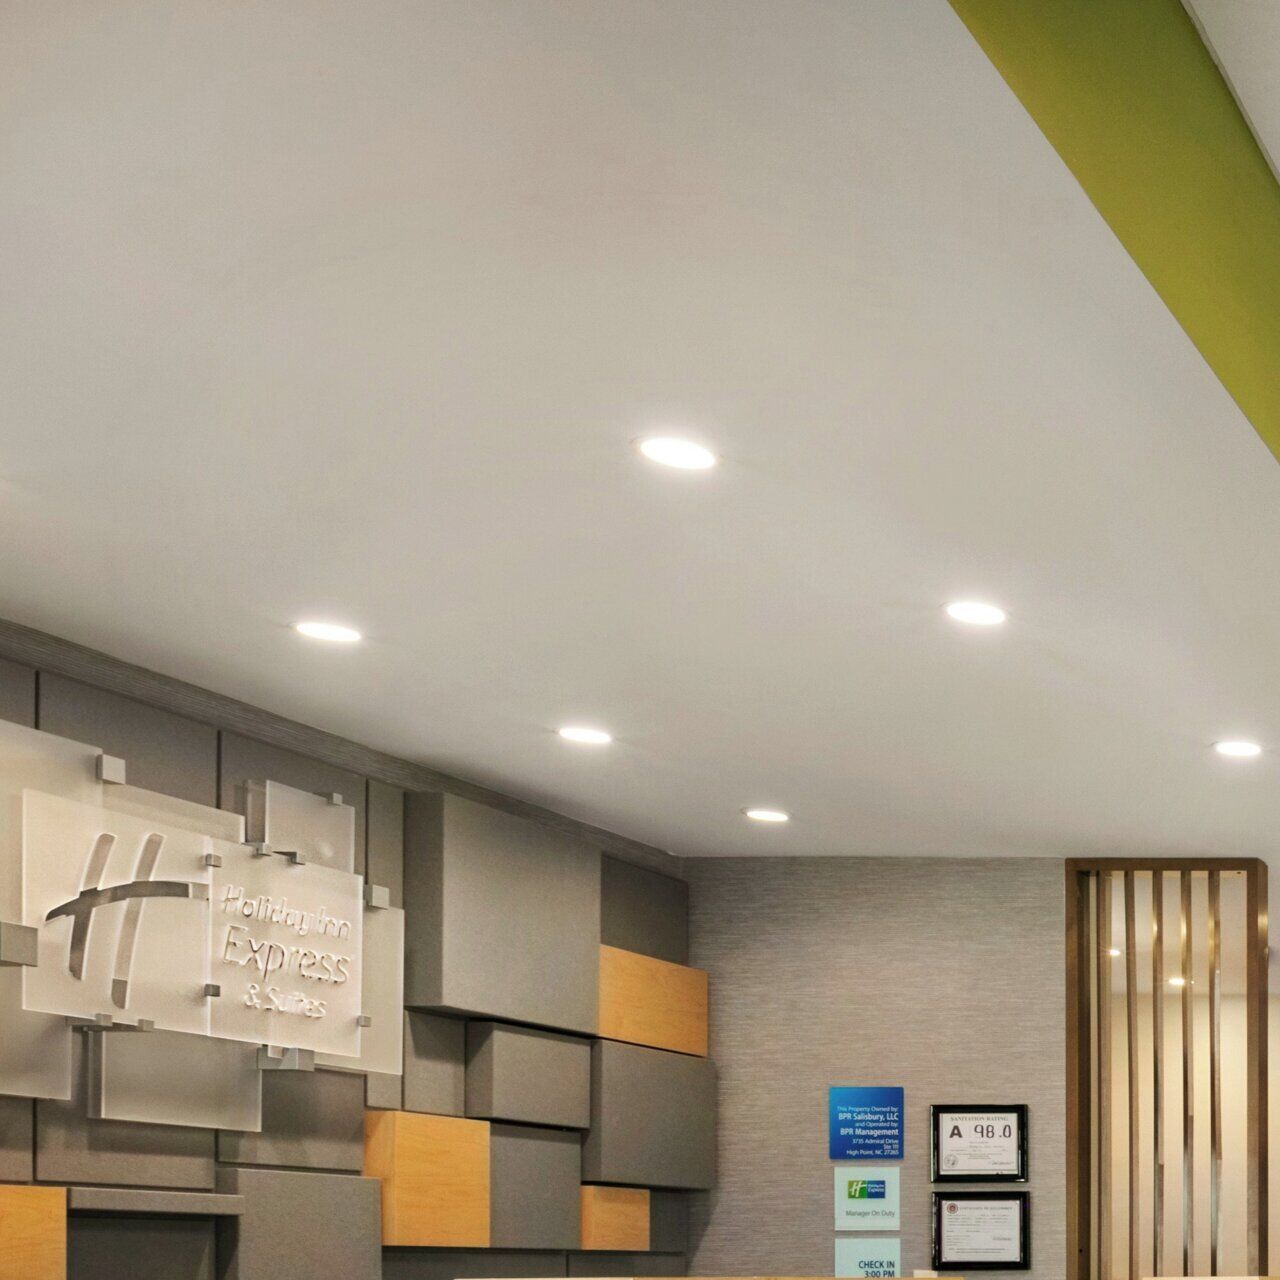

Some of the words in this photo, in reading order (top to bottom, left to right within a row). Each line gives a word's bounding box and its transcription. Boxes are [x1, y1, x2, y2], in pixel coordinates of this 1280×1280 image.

[223, 884, 310, 937] Holiday
[318, 905, 352, 940] Inn
[223, 924, 351, 984] Express
[244, 983, 260, 1009] &
[262, 986, 327, 1019] Suites
[853, 1113, 885, 1121] Salisbury,
[855, 1128, 899, 1137] Management
[949, 1125, 963, 1138] A
[974, 1124, 1012, 1138] 98.0
[858, 1260, 885, 1268] CHECK
[886, 1260, 895, 1268] IN
[864, 1270, 881, 1278] 3:00
[883, 1270, 895, 1278] PM
